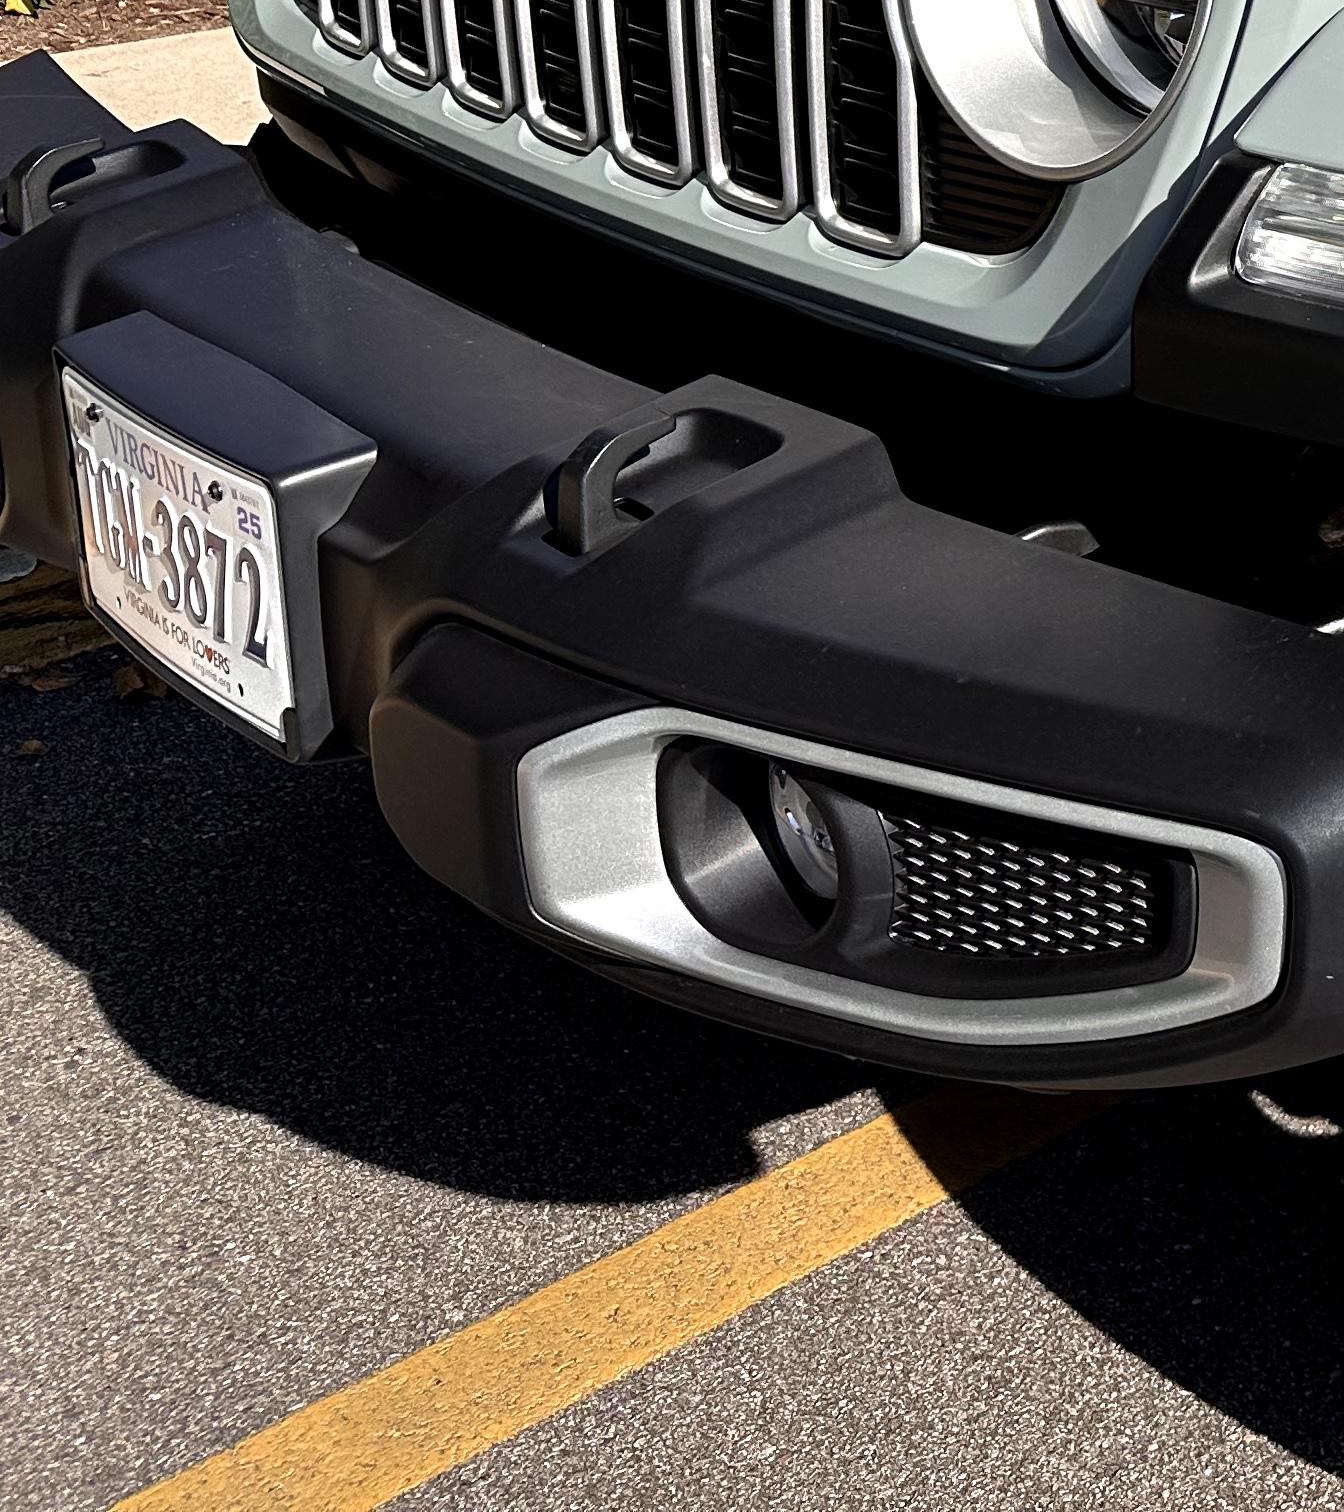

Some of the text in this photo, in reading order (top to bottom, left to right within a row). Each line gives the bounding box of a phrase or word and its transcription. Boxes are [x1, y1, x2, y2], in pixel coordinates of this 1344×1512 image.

[106, 418, 211, 515] VIRGINIA
[237, 506, 262, 540] 25
[171, 621, 191, 651] FOR
